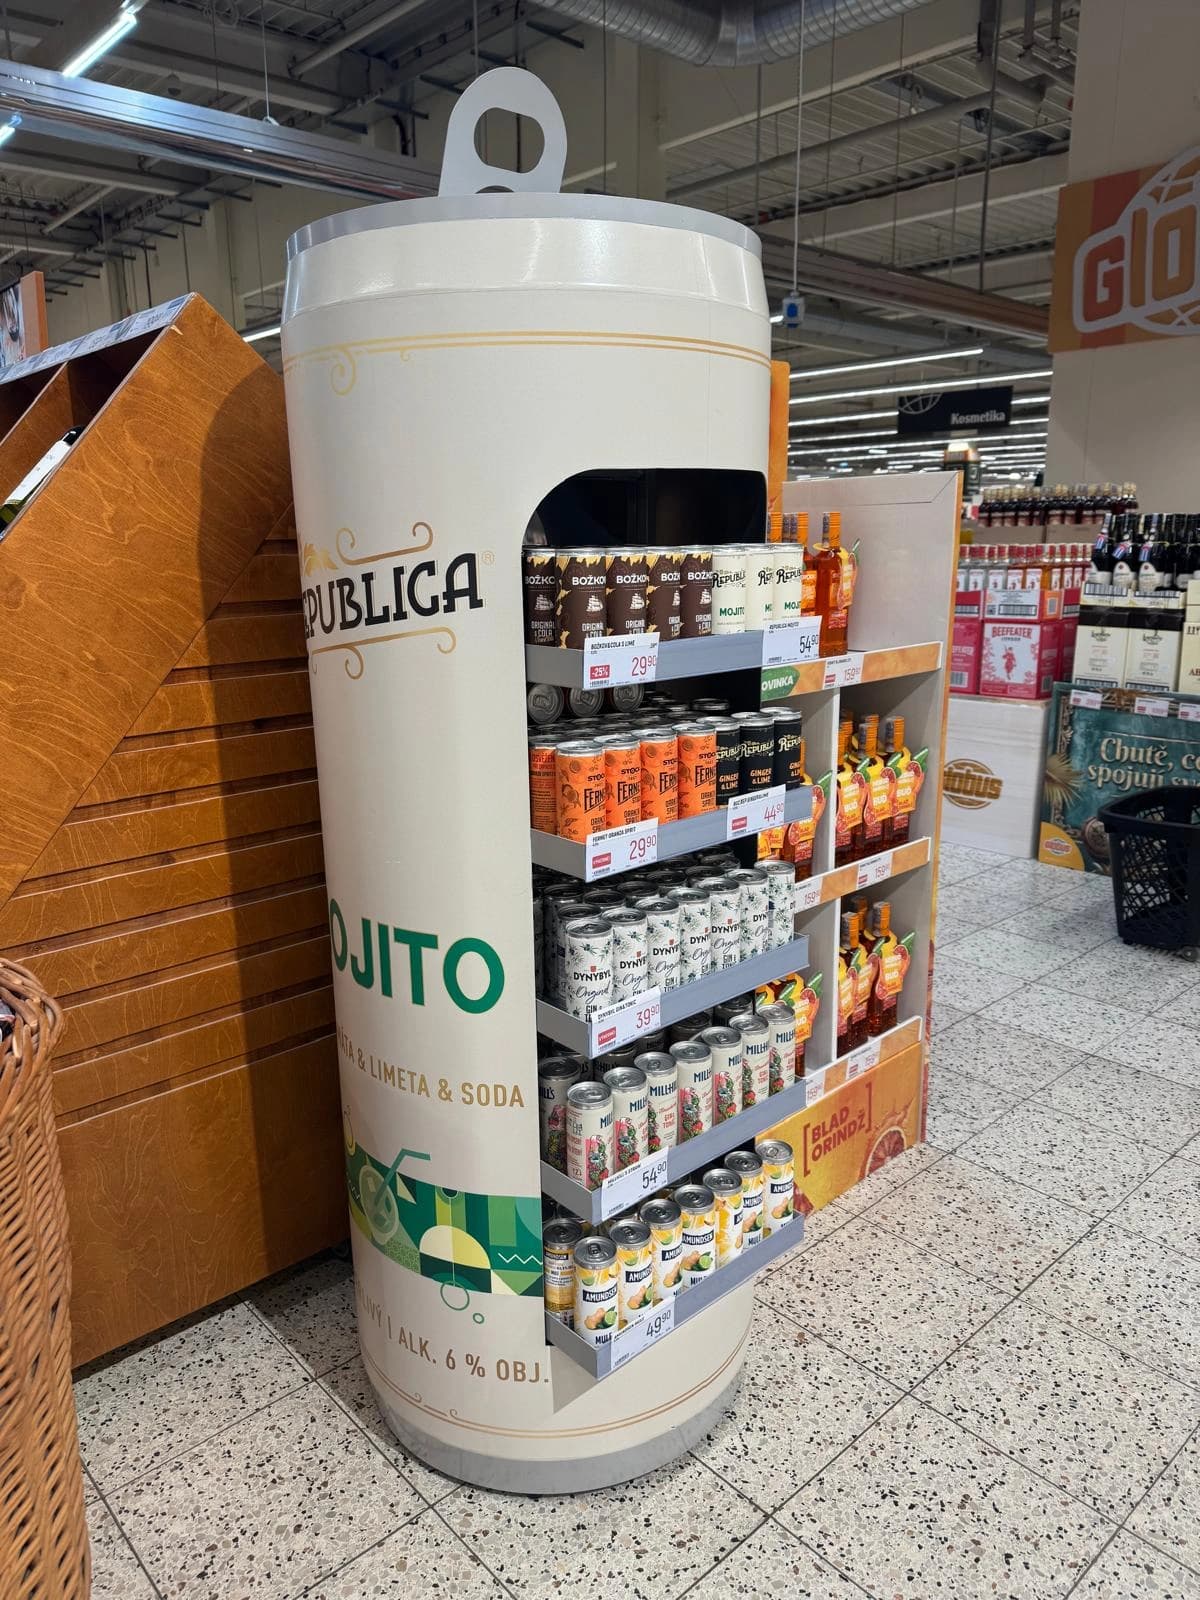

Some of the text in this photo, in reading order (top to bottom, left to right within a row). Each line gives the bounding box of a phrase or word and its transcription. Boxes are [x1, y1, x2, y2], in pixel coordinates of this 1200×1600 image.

[950, 410, 1006, 424] Kosmetika
[991, 626, 1033, 640] BEEFEATER
[591, 665, 609, 677] -25%
[1100, 737, 1174, 771] Chutě,
[943, 765, 1004, 800] lobus
[330, 898, 505, 1014] OJITO
[369, 1055, 431, 1098] LIMETA
[438, 1078, 453, 1102] &
[461, 1082, 525, 1107] SODA
[811, 1109, 865, 1161] ORINDŽ
[812, 1106, 850, 1144] BLAD
[398, 1326, 436, 1364] ALK.
[446, 1348, 456, 1370] 6
[465, 1353, 486, 1378] %
[496, 1358, 549, 1383] OBJ.
